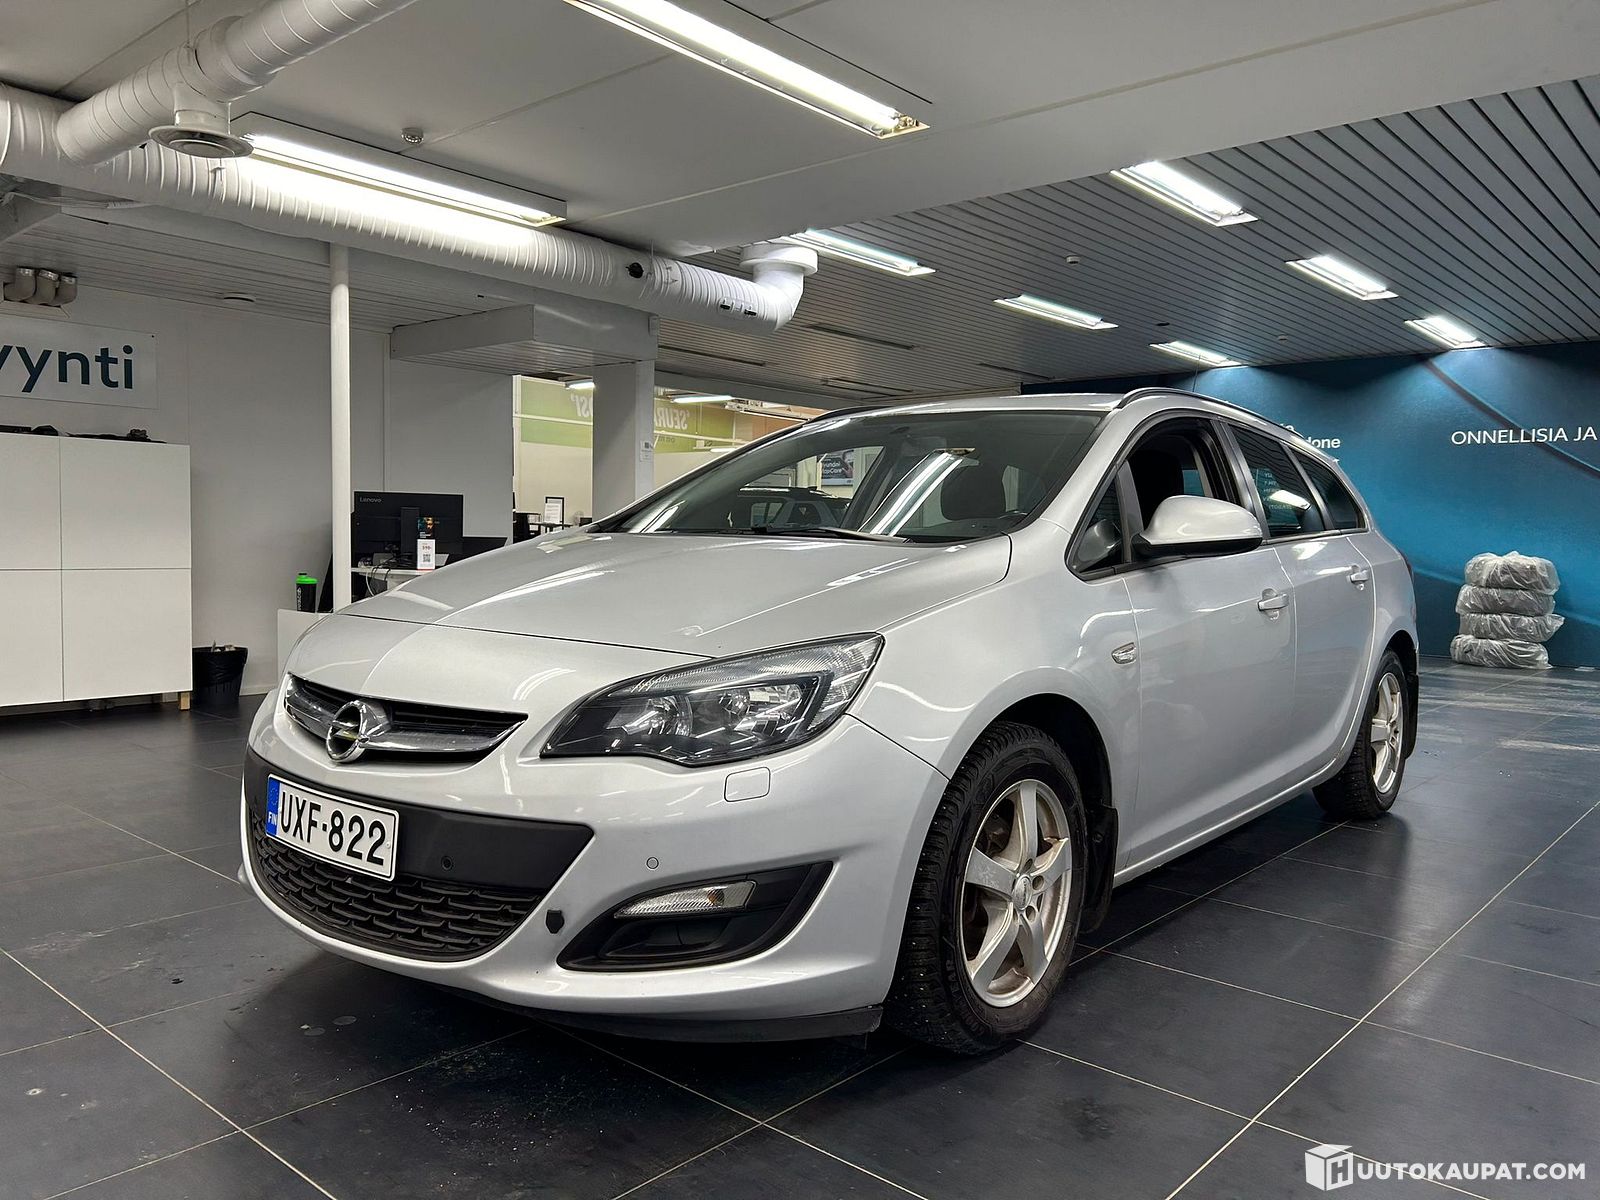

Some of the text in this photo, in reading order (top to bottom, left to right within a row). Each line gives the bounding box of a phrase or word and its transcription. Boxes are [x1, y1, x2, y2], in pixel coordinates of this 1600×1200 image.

[1451, 426, 1598, 445] ONNELLISIA JA
[268, 791, 386, 866] FIN UXF-822
